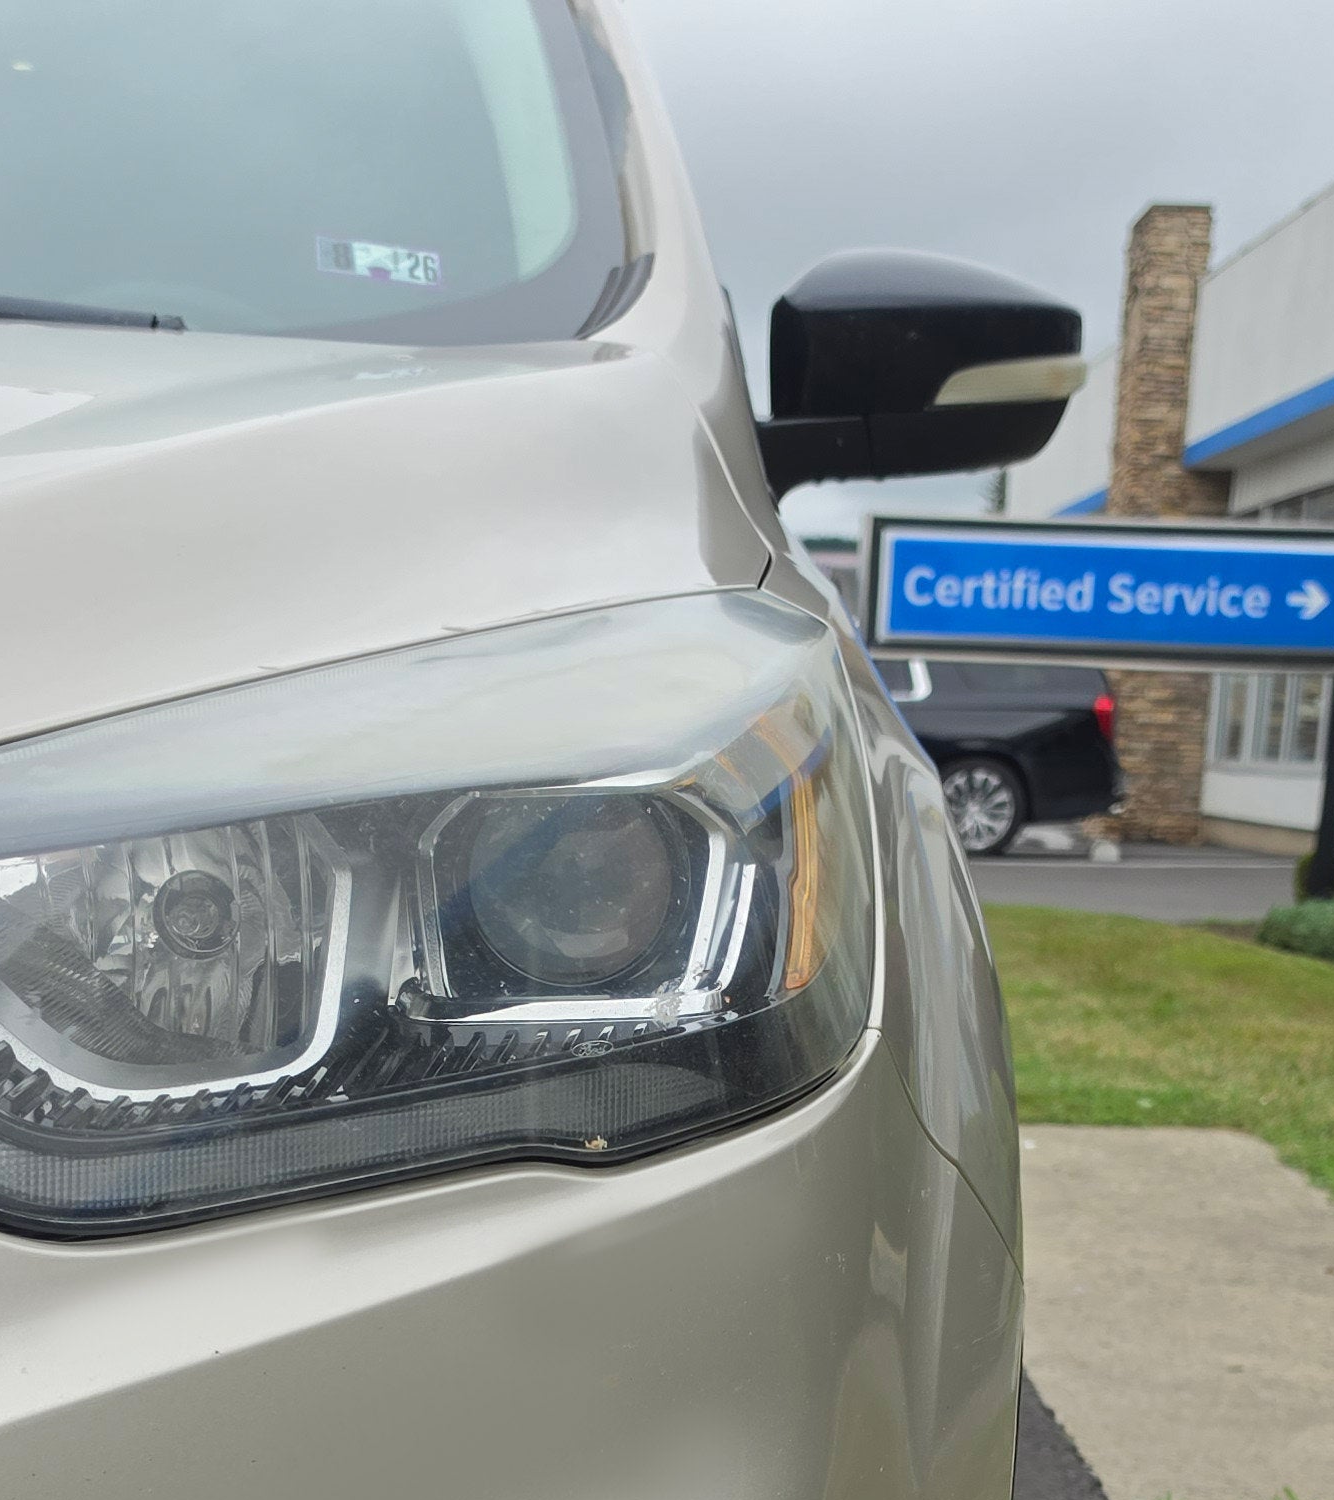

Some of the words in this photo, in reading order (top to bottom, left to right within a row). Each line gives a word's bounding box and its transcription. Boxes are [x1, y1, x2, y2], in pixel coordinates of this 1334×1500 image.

[406, 252, 438, 282] 26
[903, 566, 1095, 613] Certified
[1107, 573, 1271, 619] Service
